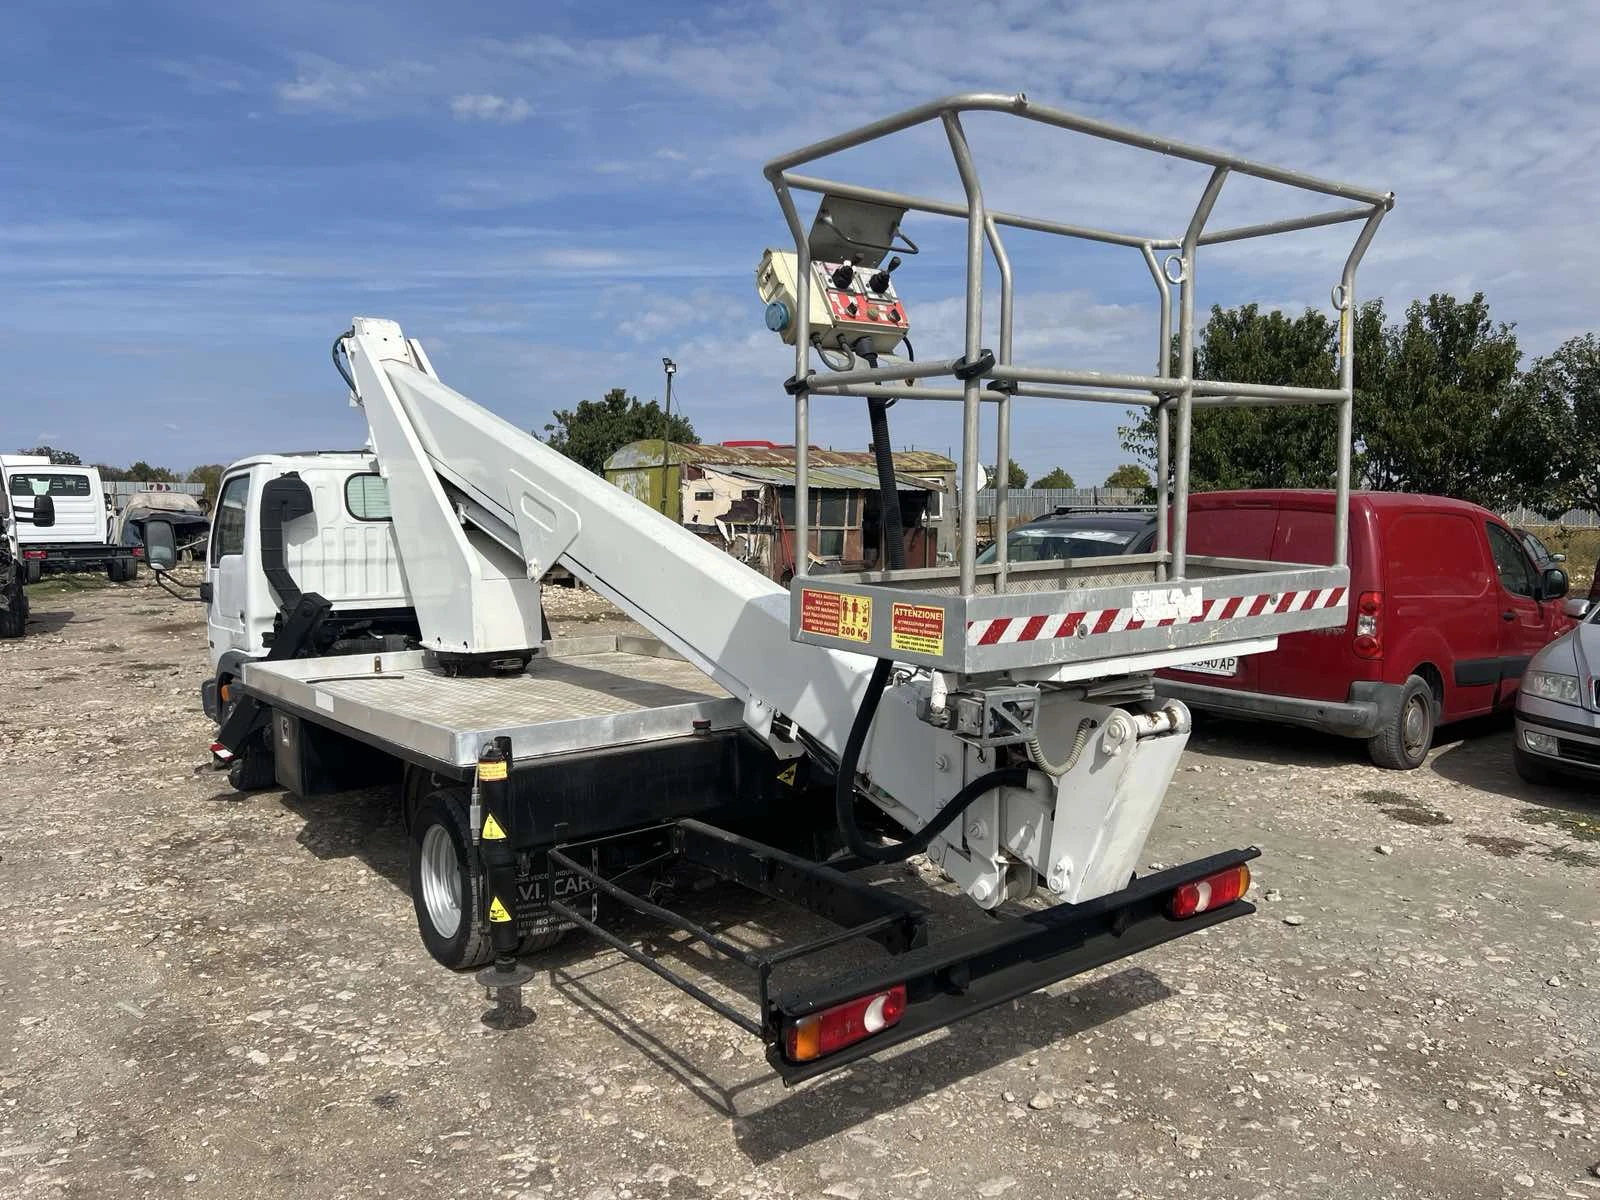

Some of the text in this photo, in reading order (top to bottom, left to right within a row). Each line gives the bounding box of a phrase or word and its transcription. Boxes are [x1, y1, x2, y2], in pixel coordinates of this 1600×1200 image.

[894, 608, 943, 620] ATTENZIONE!
[841, 626, 856, 637] 200
[857, 628, 868, 641] Kg
[1219, 658, 1235, 670] AP
